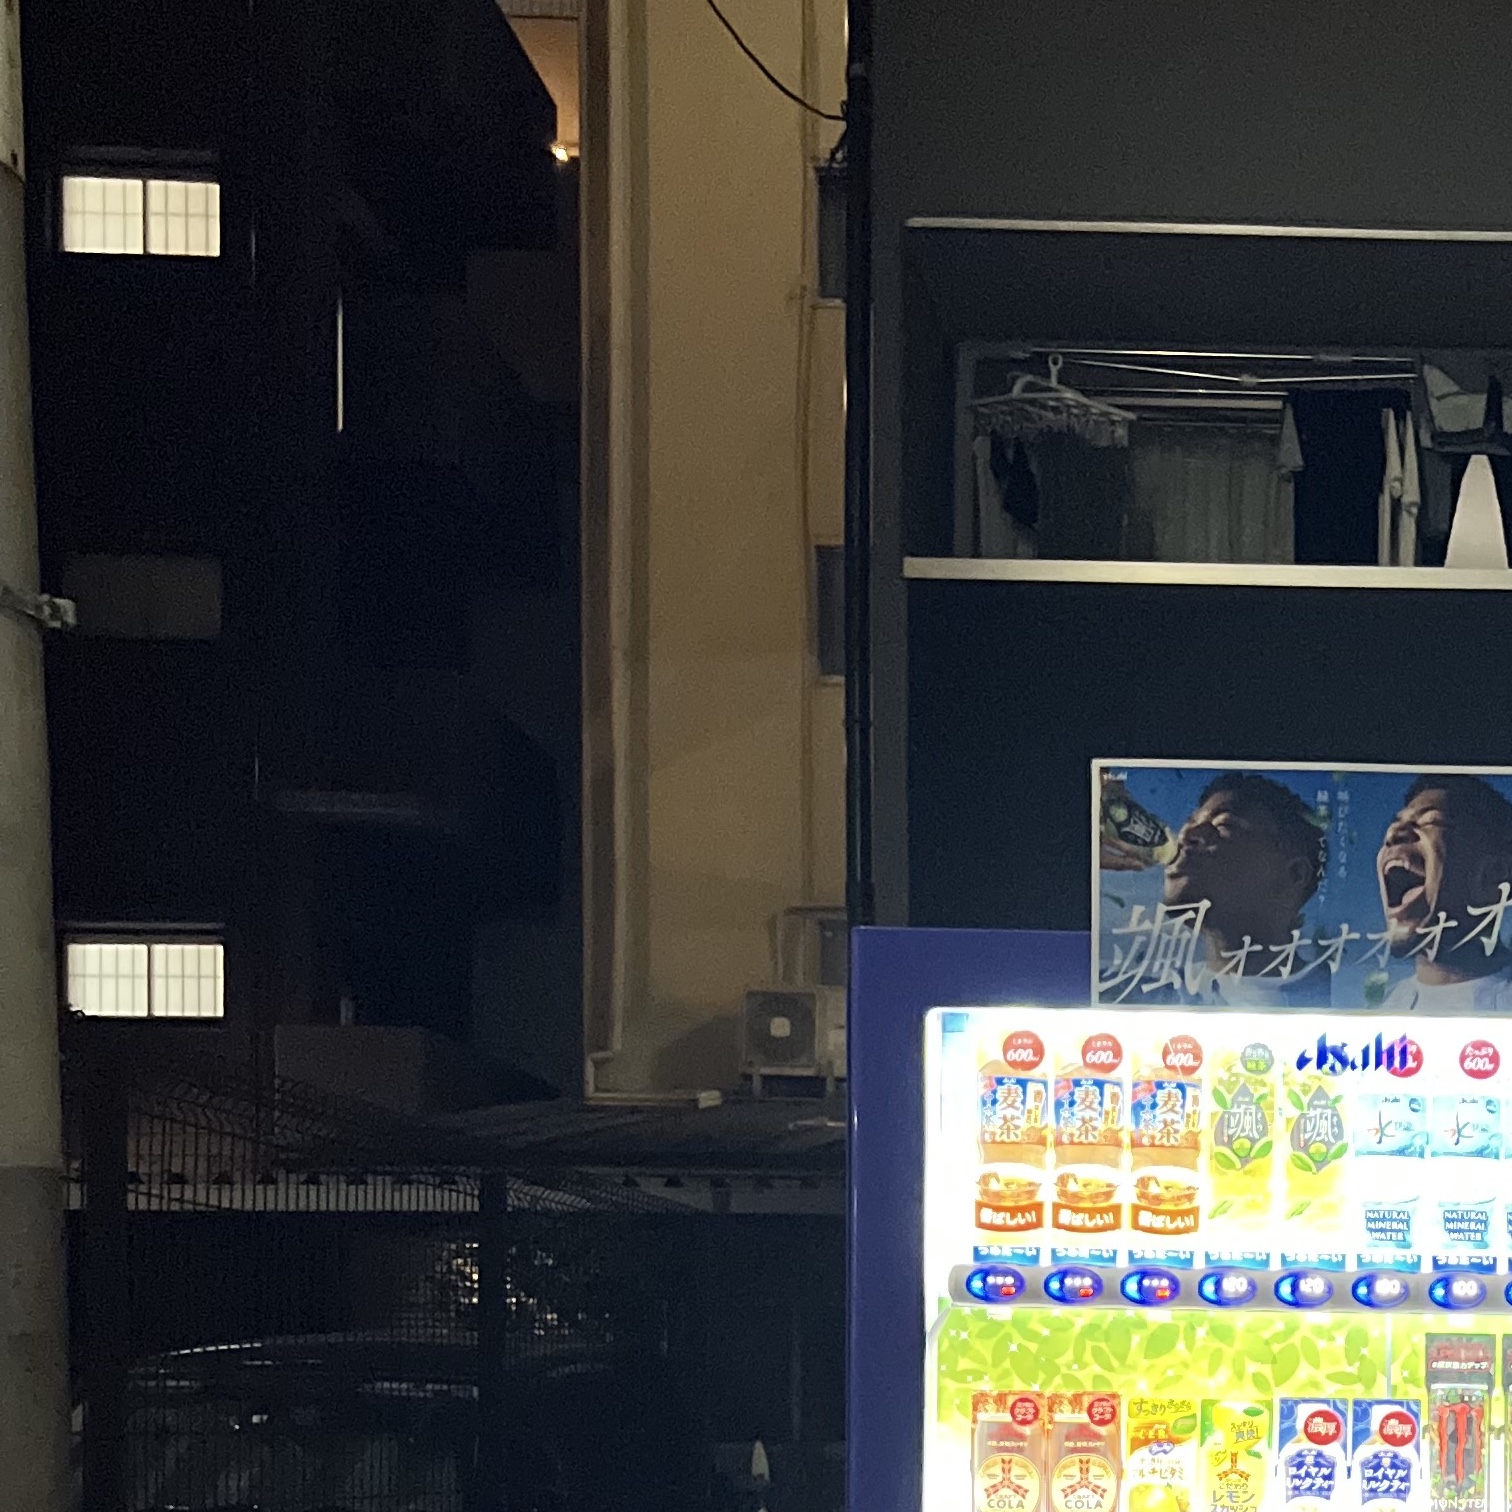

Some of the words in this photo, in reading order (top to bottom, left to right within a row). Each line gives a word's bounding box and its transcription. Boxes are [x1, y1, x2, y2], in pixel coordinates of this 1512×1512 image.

[997, 1085, 1023, 1141] 麦茶
[1076, 1086, 1101, 1142] 麦茶
[1158, 1088, 1182, 1145] 麦茶
[1365, 1210, 1410, 1221] NATURAL
[1443, 1210, 1488, 1221] NATURAL
[1366, 1221, 1409, 1231] MINERAL
[1445, 1221, 1487, 1231] MINERAL
[1371, 1231, 1405, 1242] WATER
[1449, 1231, 1484, 1242] WATER
[1288, 1466, 1332, 1480] ロイヤル
[1364, 1468, 1408, 1482] ロイヤル
[1212, 1490, 1255, 1503] レモン
[987, 1499, 1025, 1510] COLA
[1064, 1499, 1103, 1510] COLA
